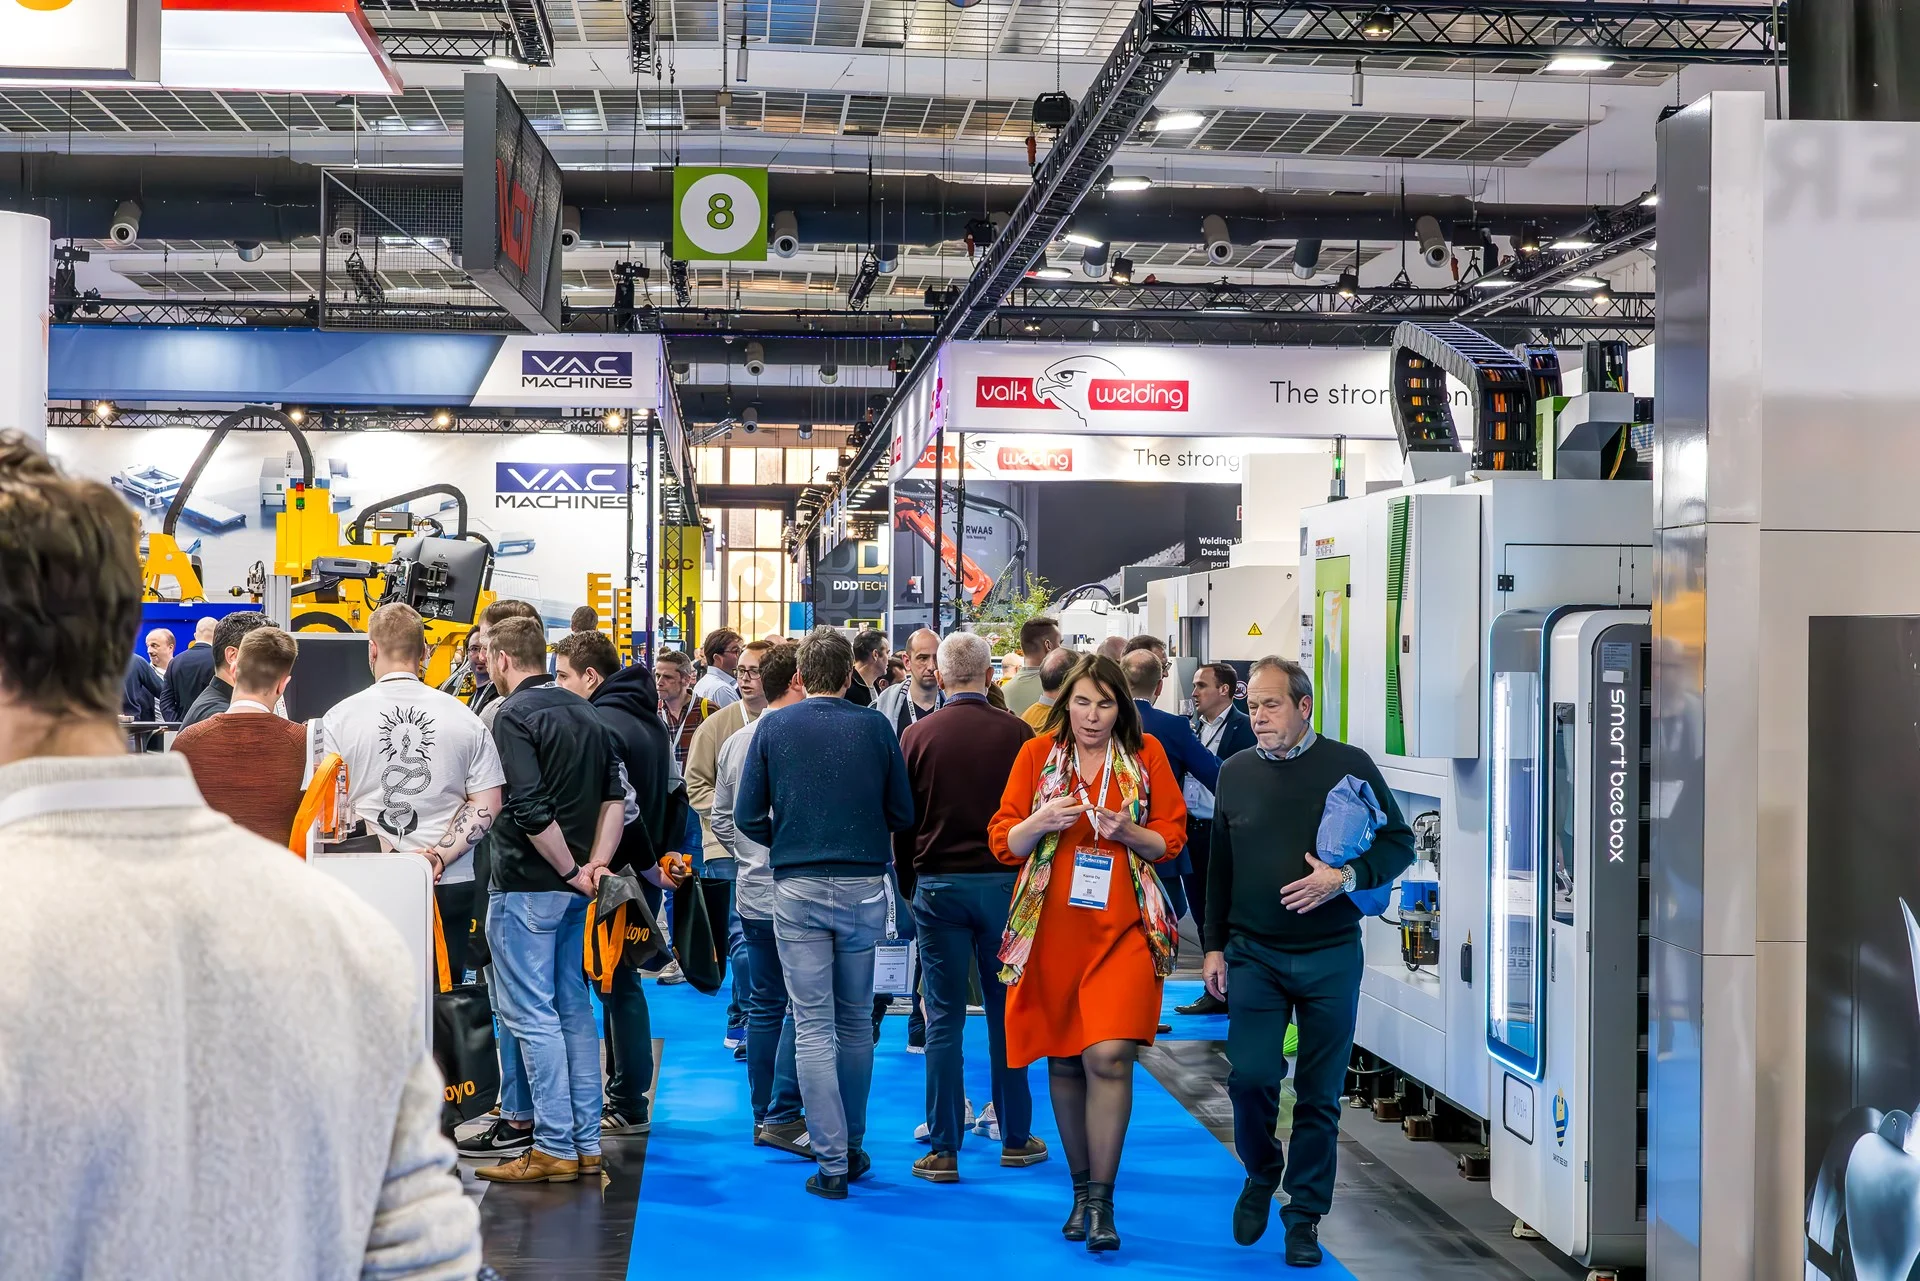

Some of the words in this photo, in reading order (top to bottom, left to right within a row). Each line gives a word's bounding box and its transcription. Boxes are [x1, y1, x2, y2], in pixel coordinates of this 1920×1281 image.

[707, 192, 734, 230] 8
[521, 376, 632, 389] MACHINES
[1269, 380, 1318, 403] The
[1328, 383, 1391, 404] stron
[981, 380, 1027, 401] valk
[1096, 382, 1184, 409] welding
[1002, 447, 1069, 471] welding
[1133, 449, 1170, 467] The
[1177, 451, 1240, 472] strong
[1199, 537, 1232, 546] Welding
[833, 580, 887, 591] DDDTECH
